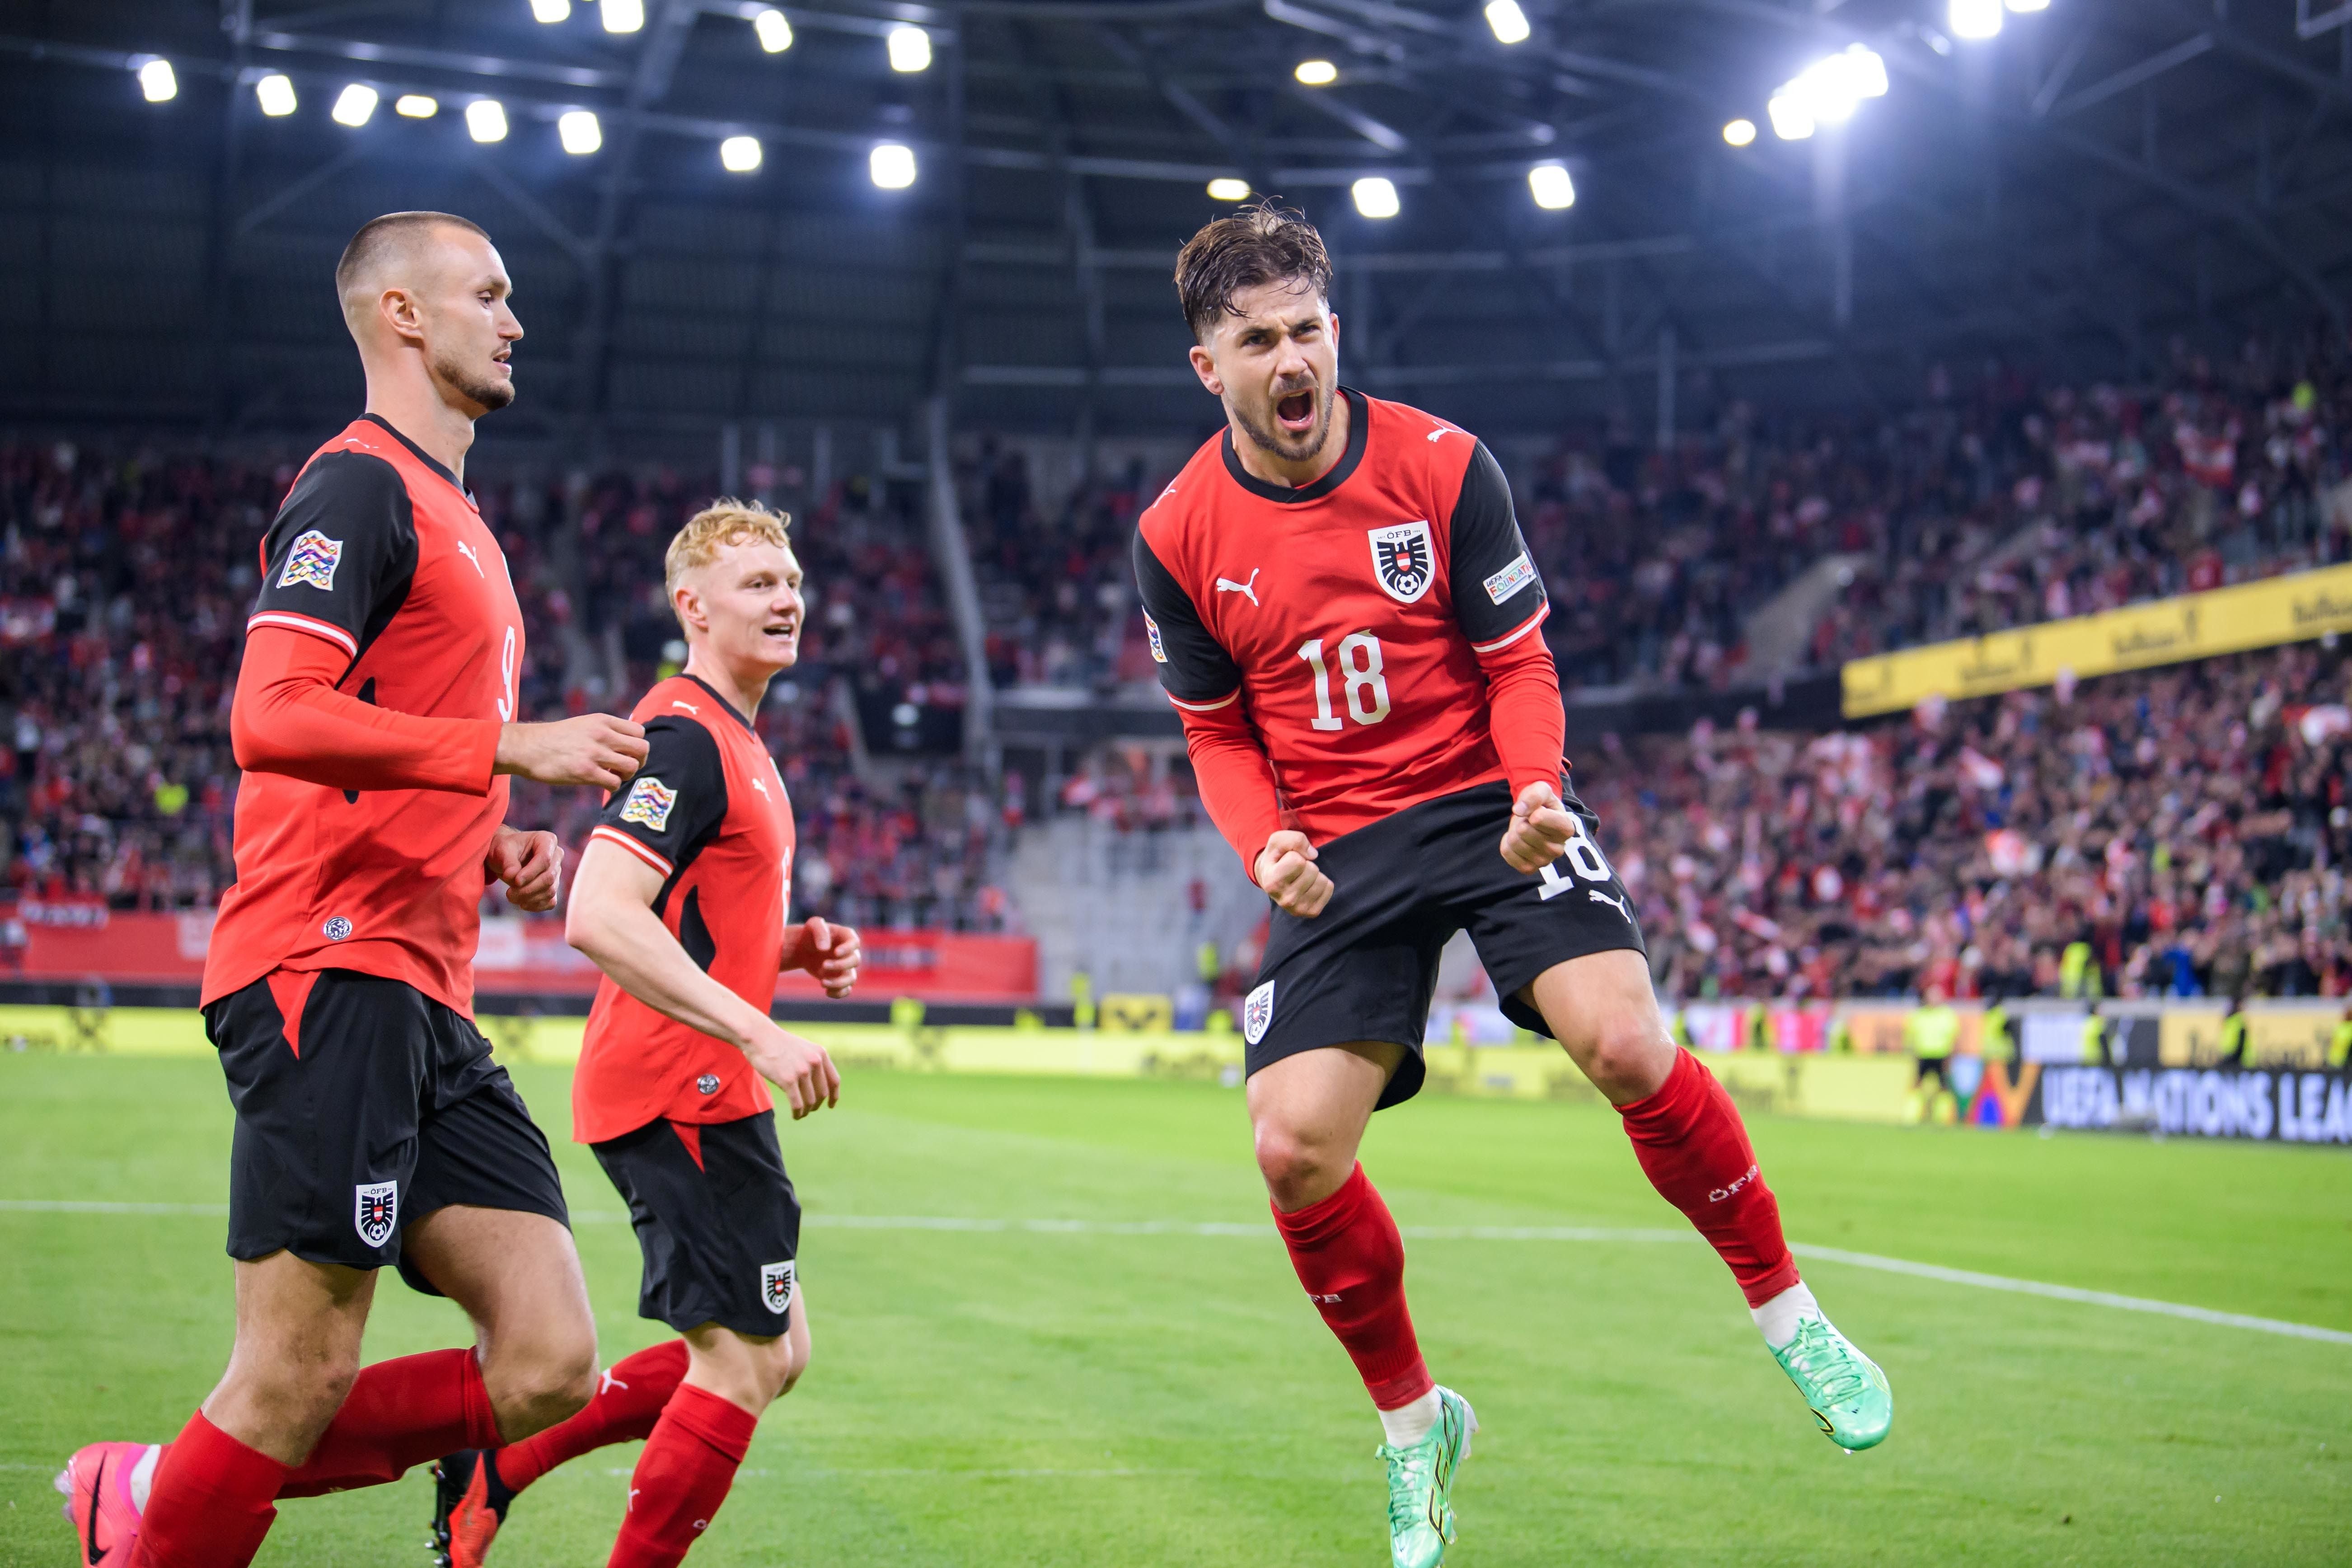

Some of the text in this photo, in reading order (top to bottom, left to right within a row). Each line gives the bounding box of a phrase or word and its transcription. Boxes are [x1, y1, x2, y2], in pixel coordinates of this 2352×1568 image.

[1387, 529, 1411, 539] ÖFB
[1486, 575, 1502, 587] UEFA
[497, 625, 515, 722] 9
[1297, 628, 1391, 731] 18
[2042, 1067, 2120, 1127] UEFA
[2278, 1072, 2352, 1143] LEA
